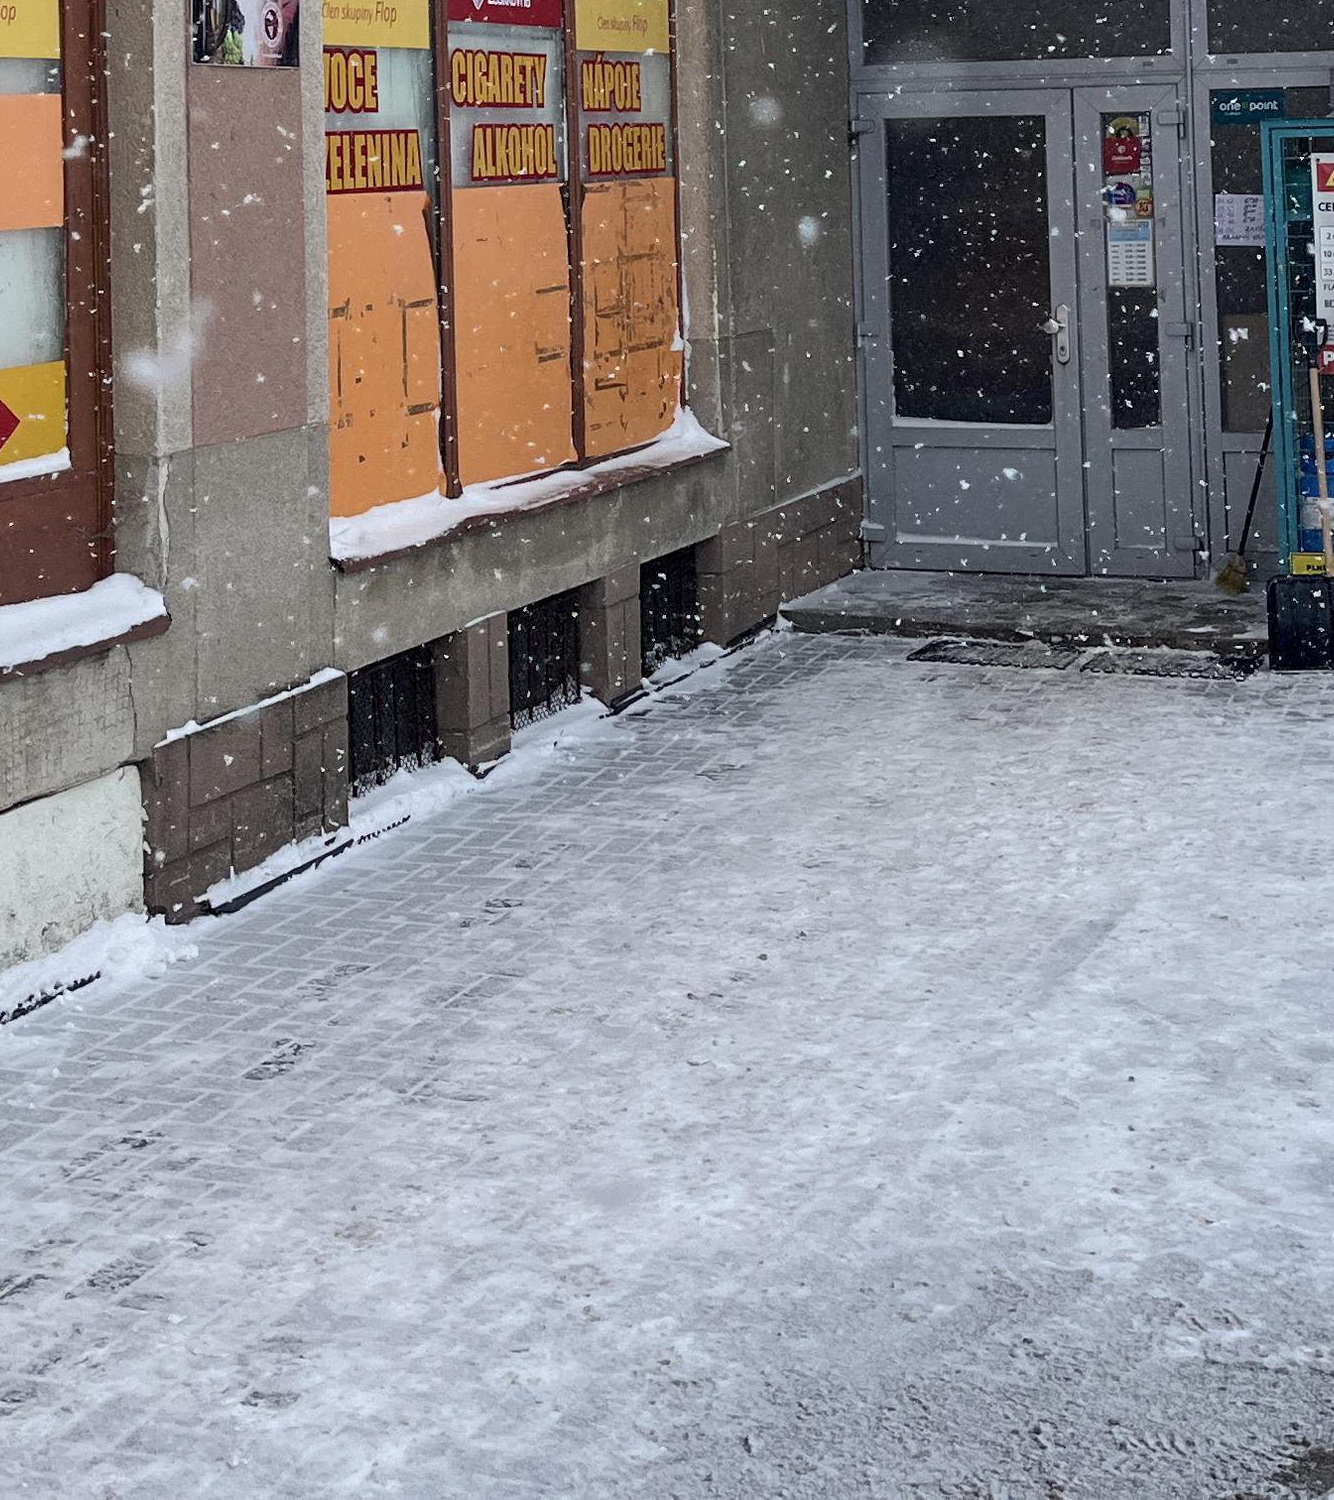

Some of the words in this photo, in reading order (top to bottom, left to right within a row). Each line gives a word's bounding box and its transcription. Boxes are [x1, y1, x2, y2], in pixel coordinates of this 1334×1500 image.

[342, 3, 373, 25] skupiny
[375, 1, 397, 28] Flop
[452, 49, 546, 107] CIGARETY
[581, 53, 641, 111] NÁPOJE
[1249, 100, 1278, 111] point
[472, 123, 557, 181] ALKOHOL
[588, 122, 666, 175] DROGERIE
